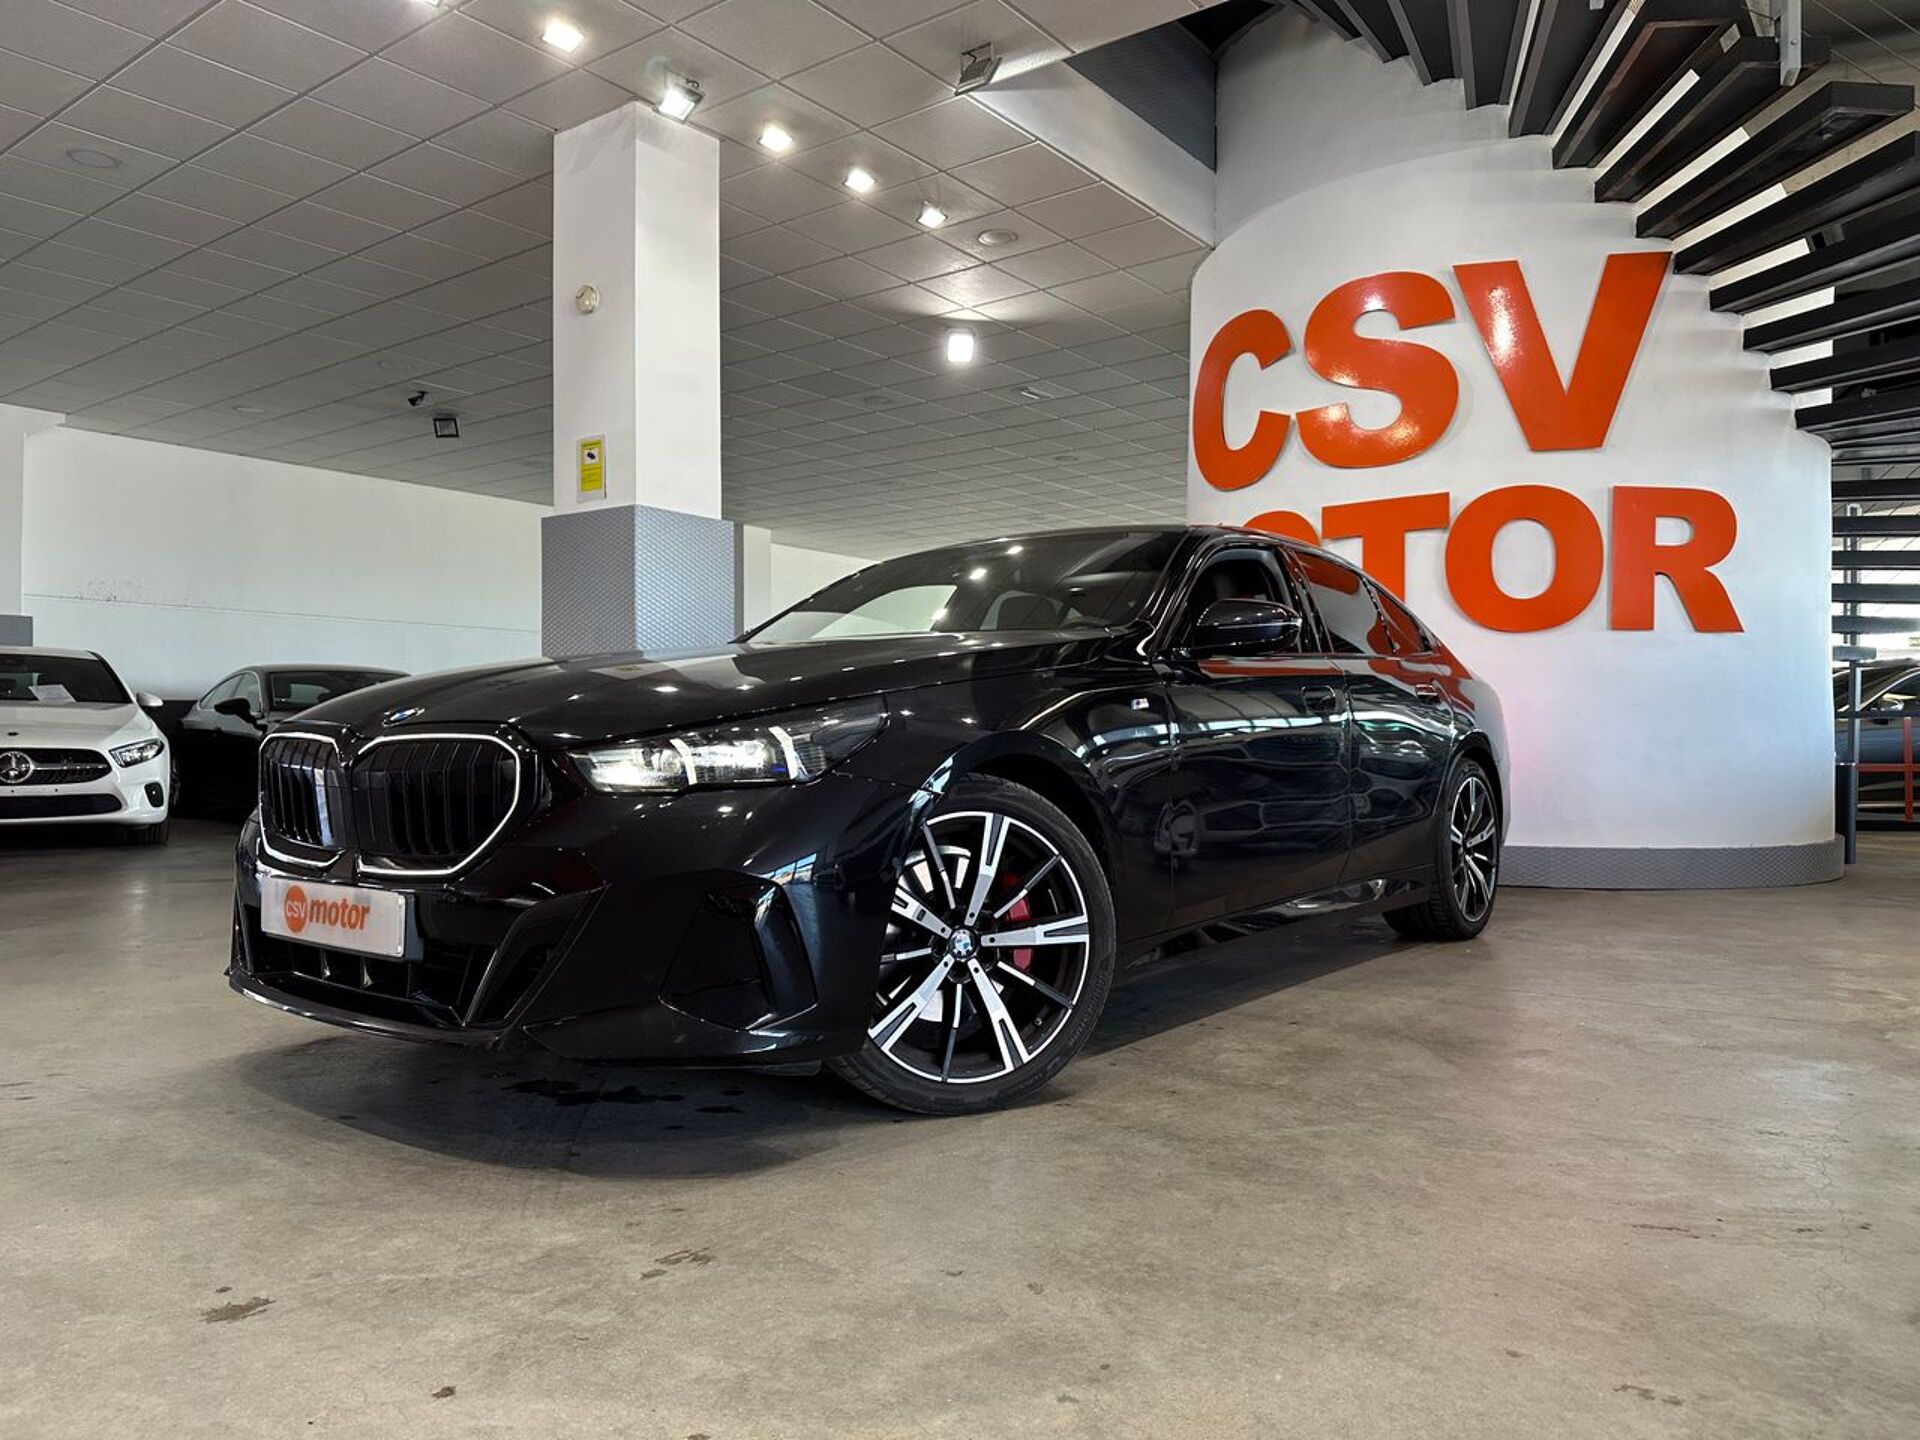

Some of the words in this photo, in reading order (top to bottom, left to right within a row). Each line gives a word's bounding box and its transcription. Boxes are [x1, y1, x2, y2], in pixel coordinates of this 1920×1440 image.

[1192, 251, 1673, 491] CSV
[1240, 484, 1745, 633] TOR
[309, 898, 370, 930] motor
